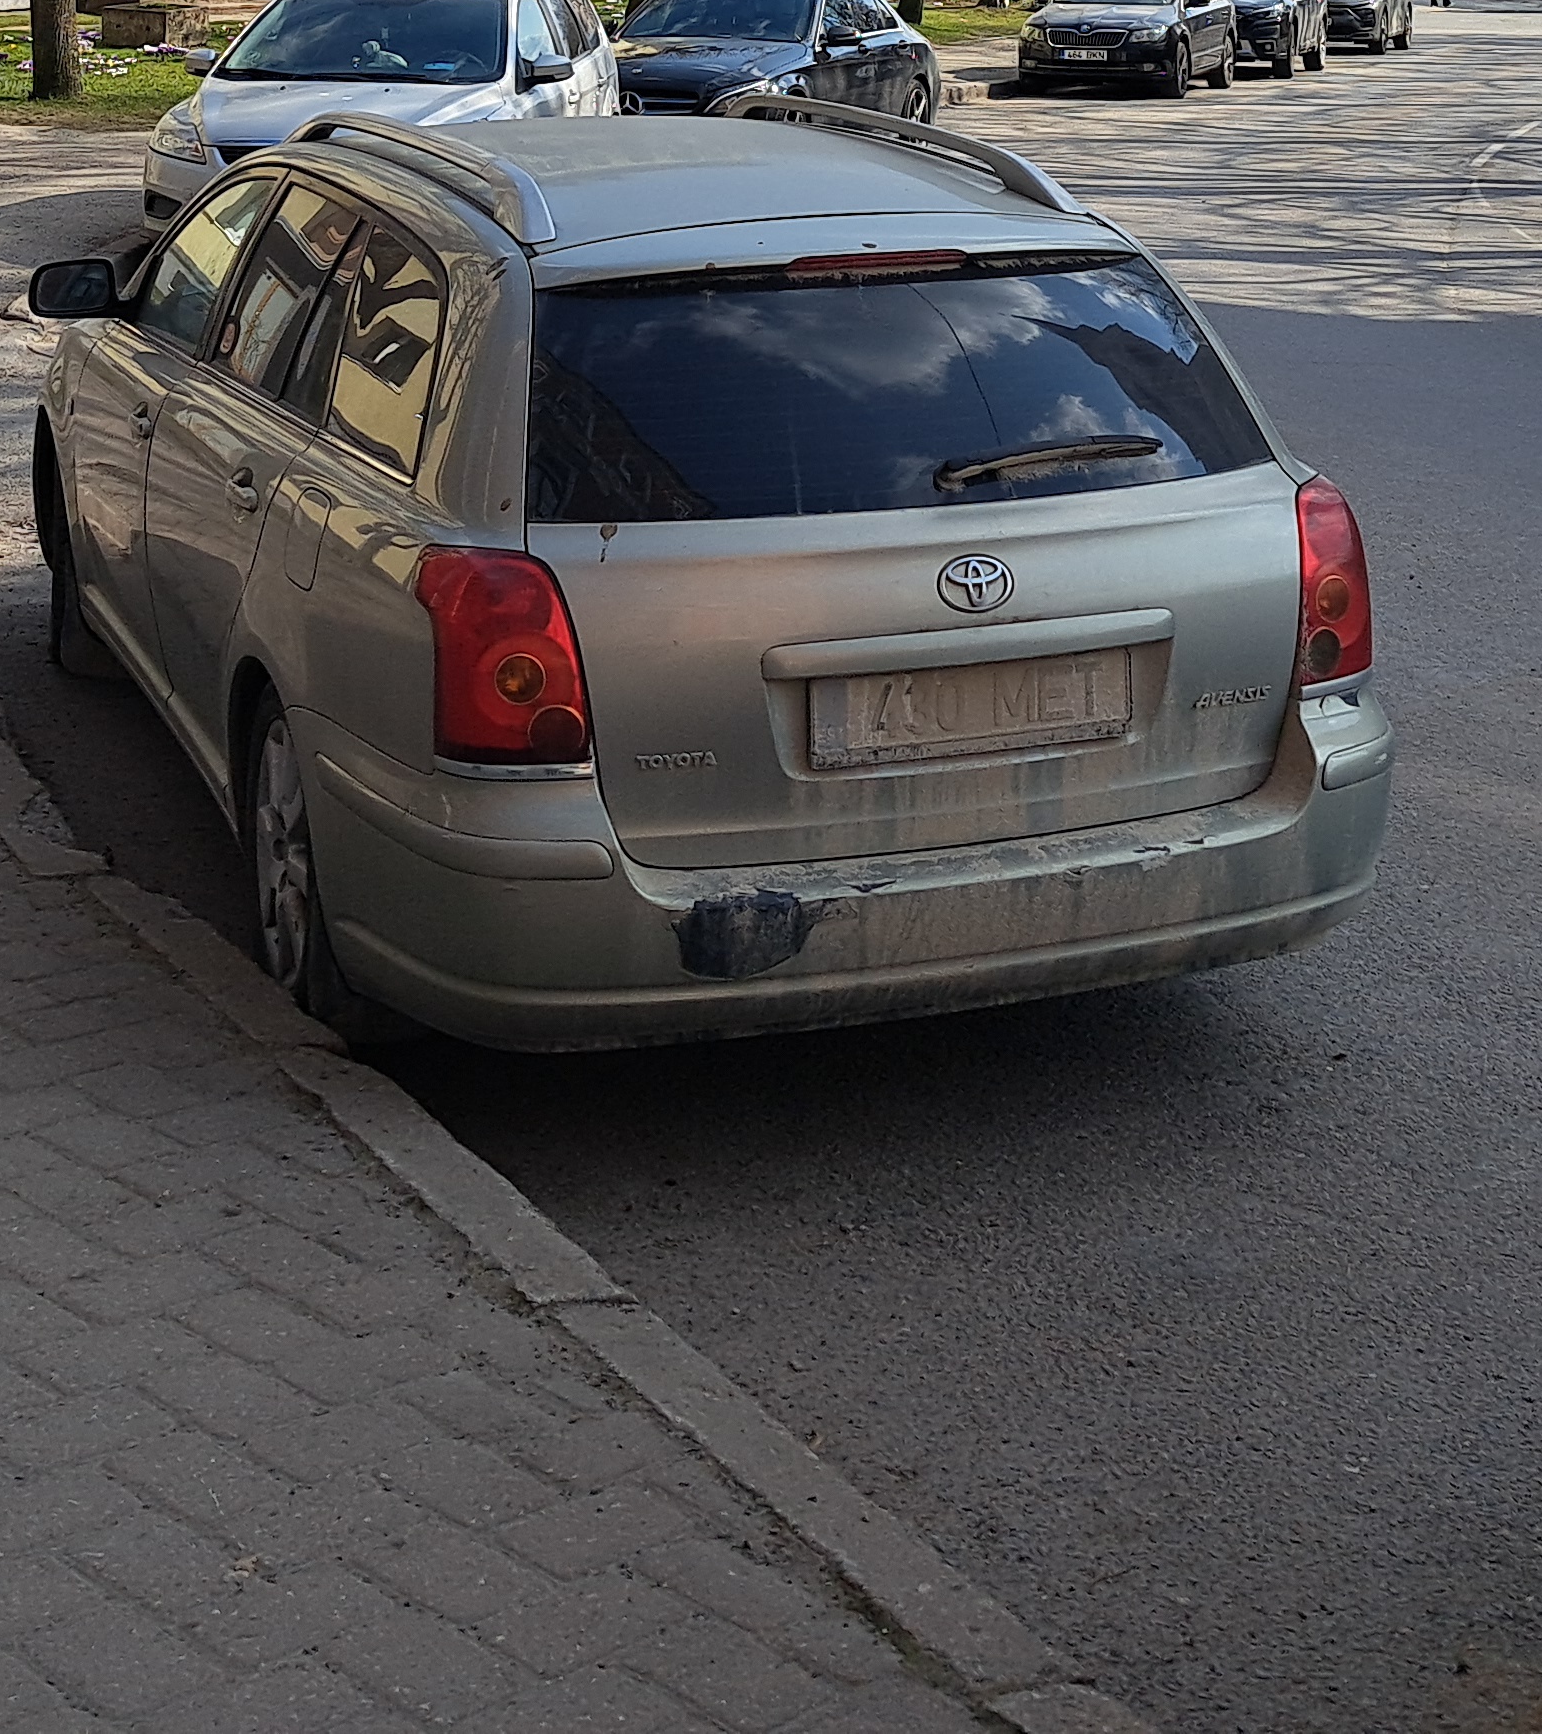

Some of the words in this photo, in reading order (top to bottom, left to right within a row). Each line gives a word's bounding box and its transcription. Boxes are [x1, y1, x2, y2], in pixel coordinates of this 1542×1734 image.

[992, 658, 1106, 728] MET
[1192, 684, 1272, 709] AVENSIS
[635, 750, 718, 770] TOYOTA
